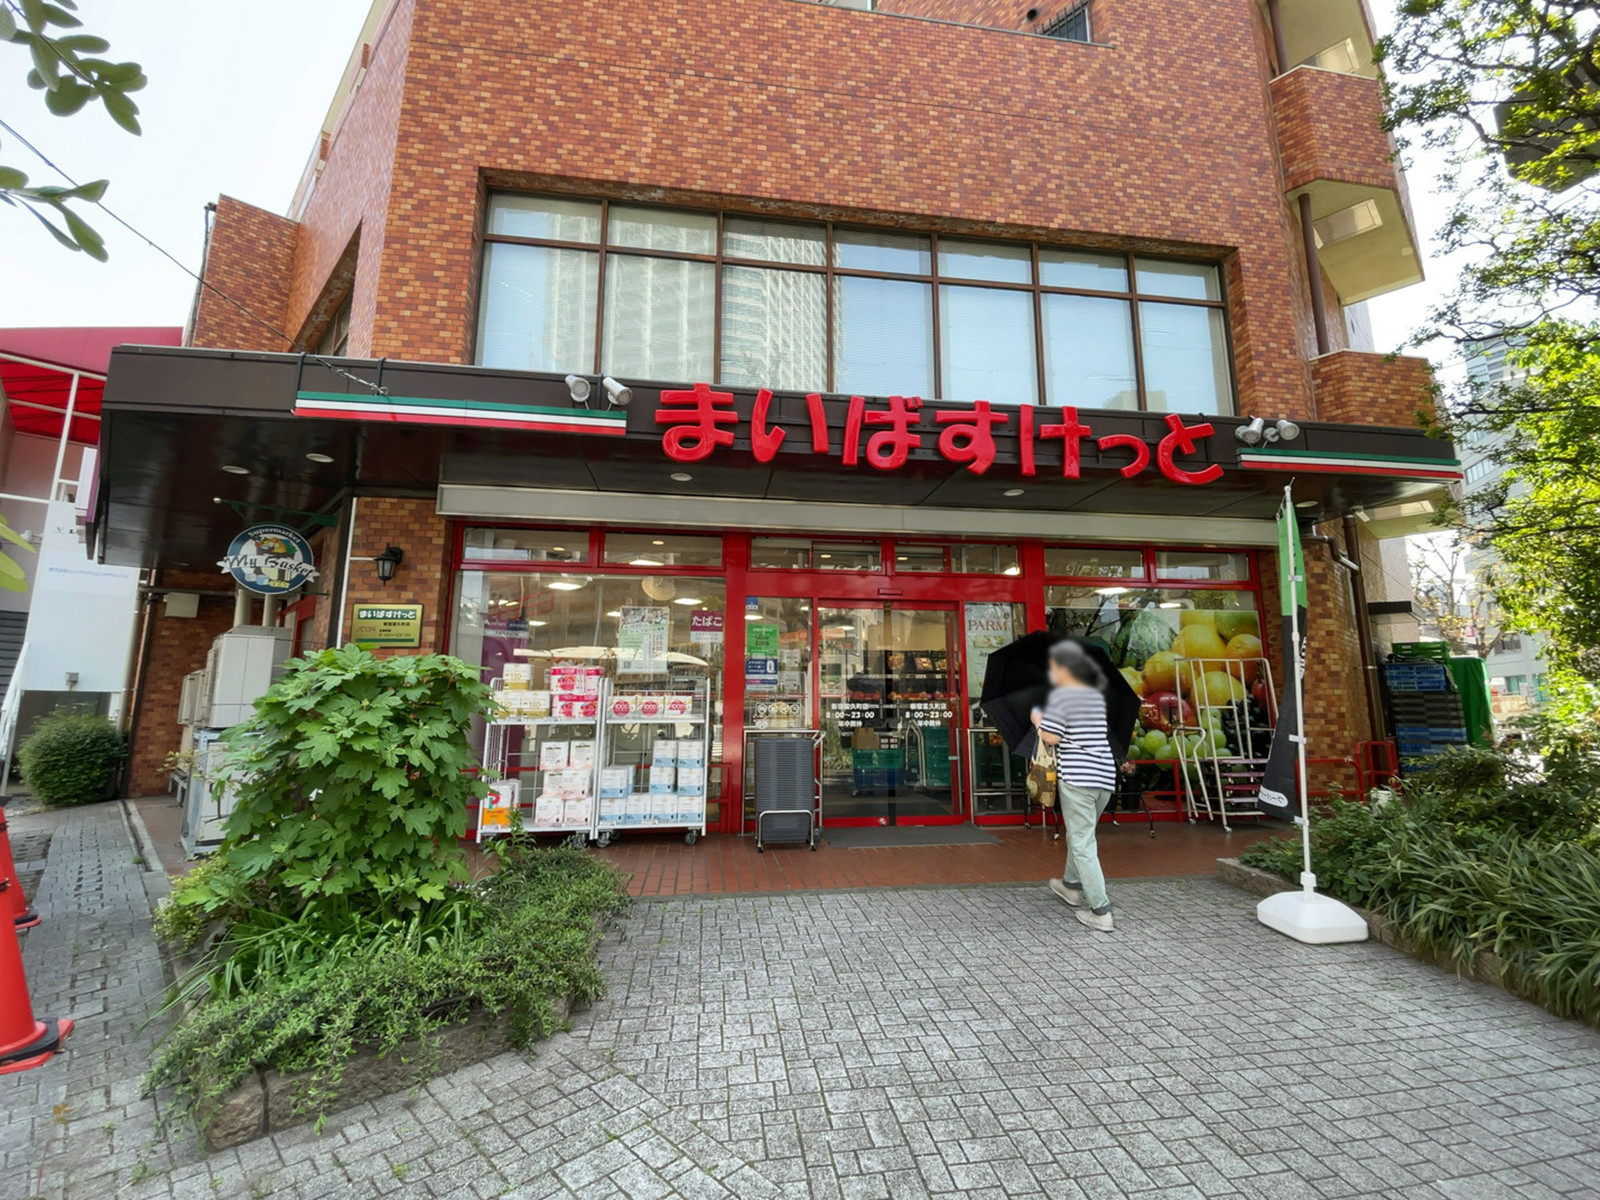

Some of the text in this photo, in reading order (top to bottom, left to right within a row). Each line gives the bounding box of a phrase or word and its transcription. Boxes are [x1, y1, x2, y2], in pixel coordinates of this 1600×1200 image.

[655, 382, 1224, 485] まいばすけっと
[248, 528, 301, 543] Supermarket
[224, 554, 314, 577] My Basket
[359, 610, 416, 619] まいばすけっと
[691, 615, 723, 627] たばこ
[968, 620, 1007, 631] PARM
